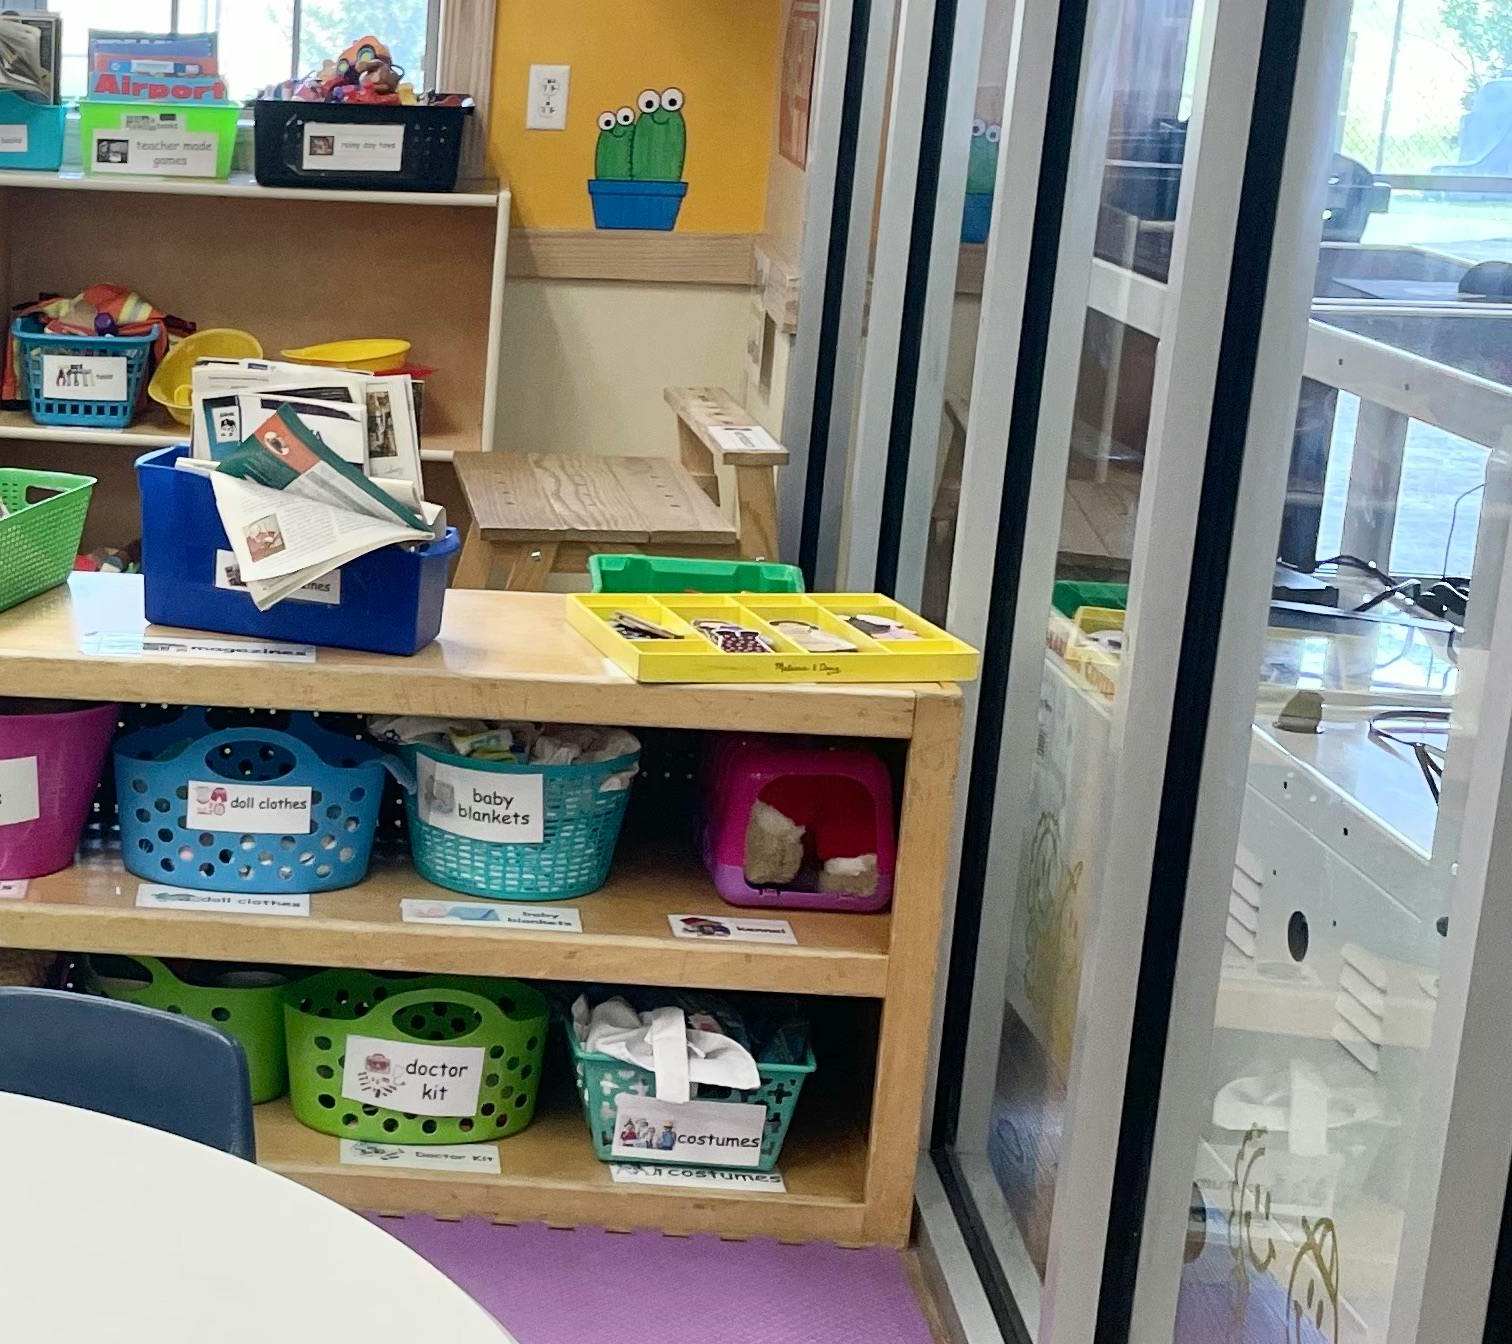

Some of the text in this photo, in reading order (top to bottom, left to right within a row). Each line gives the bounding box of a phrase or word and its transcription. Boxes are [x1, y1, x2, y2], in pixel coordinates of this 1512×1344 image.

[94, 74, 226, 99] Airport
[136, 140, 179, 152] teacher
[152, 157, 187, 169] games
[230, 796, 307, 811] doll clothes
[472, 788, 514, 810] baby
[458, 804, 530, 825] blankets
[405, 1058, 468, 1078] doctor
[422, 1083, 448, 1101] kit
[677, 1133, 760, 1149] costumes
[668, 1167, 781, 1183] costumes
